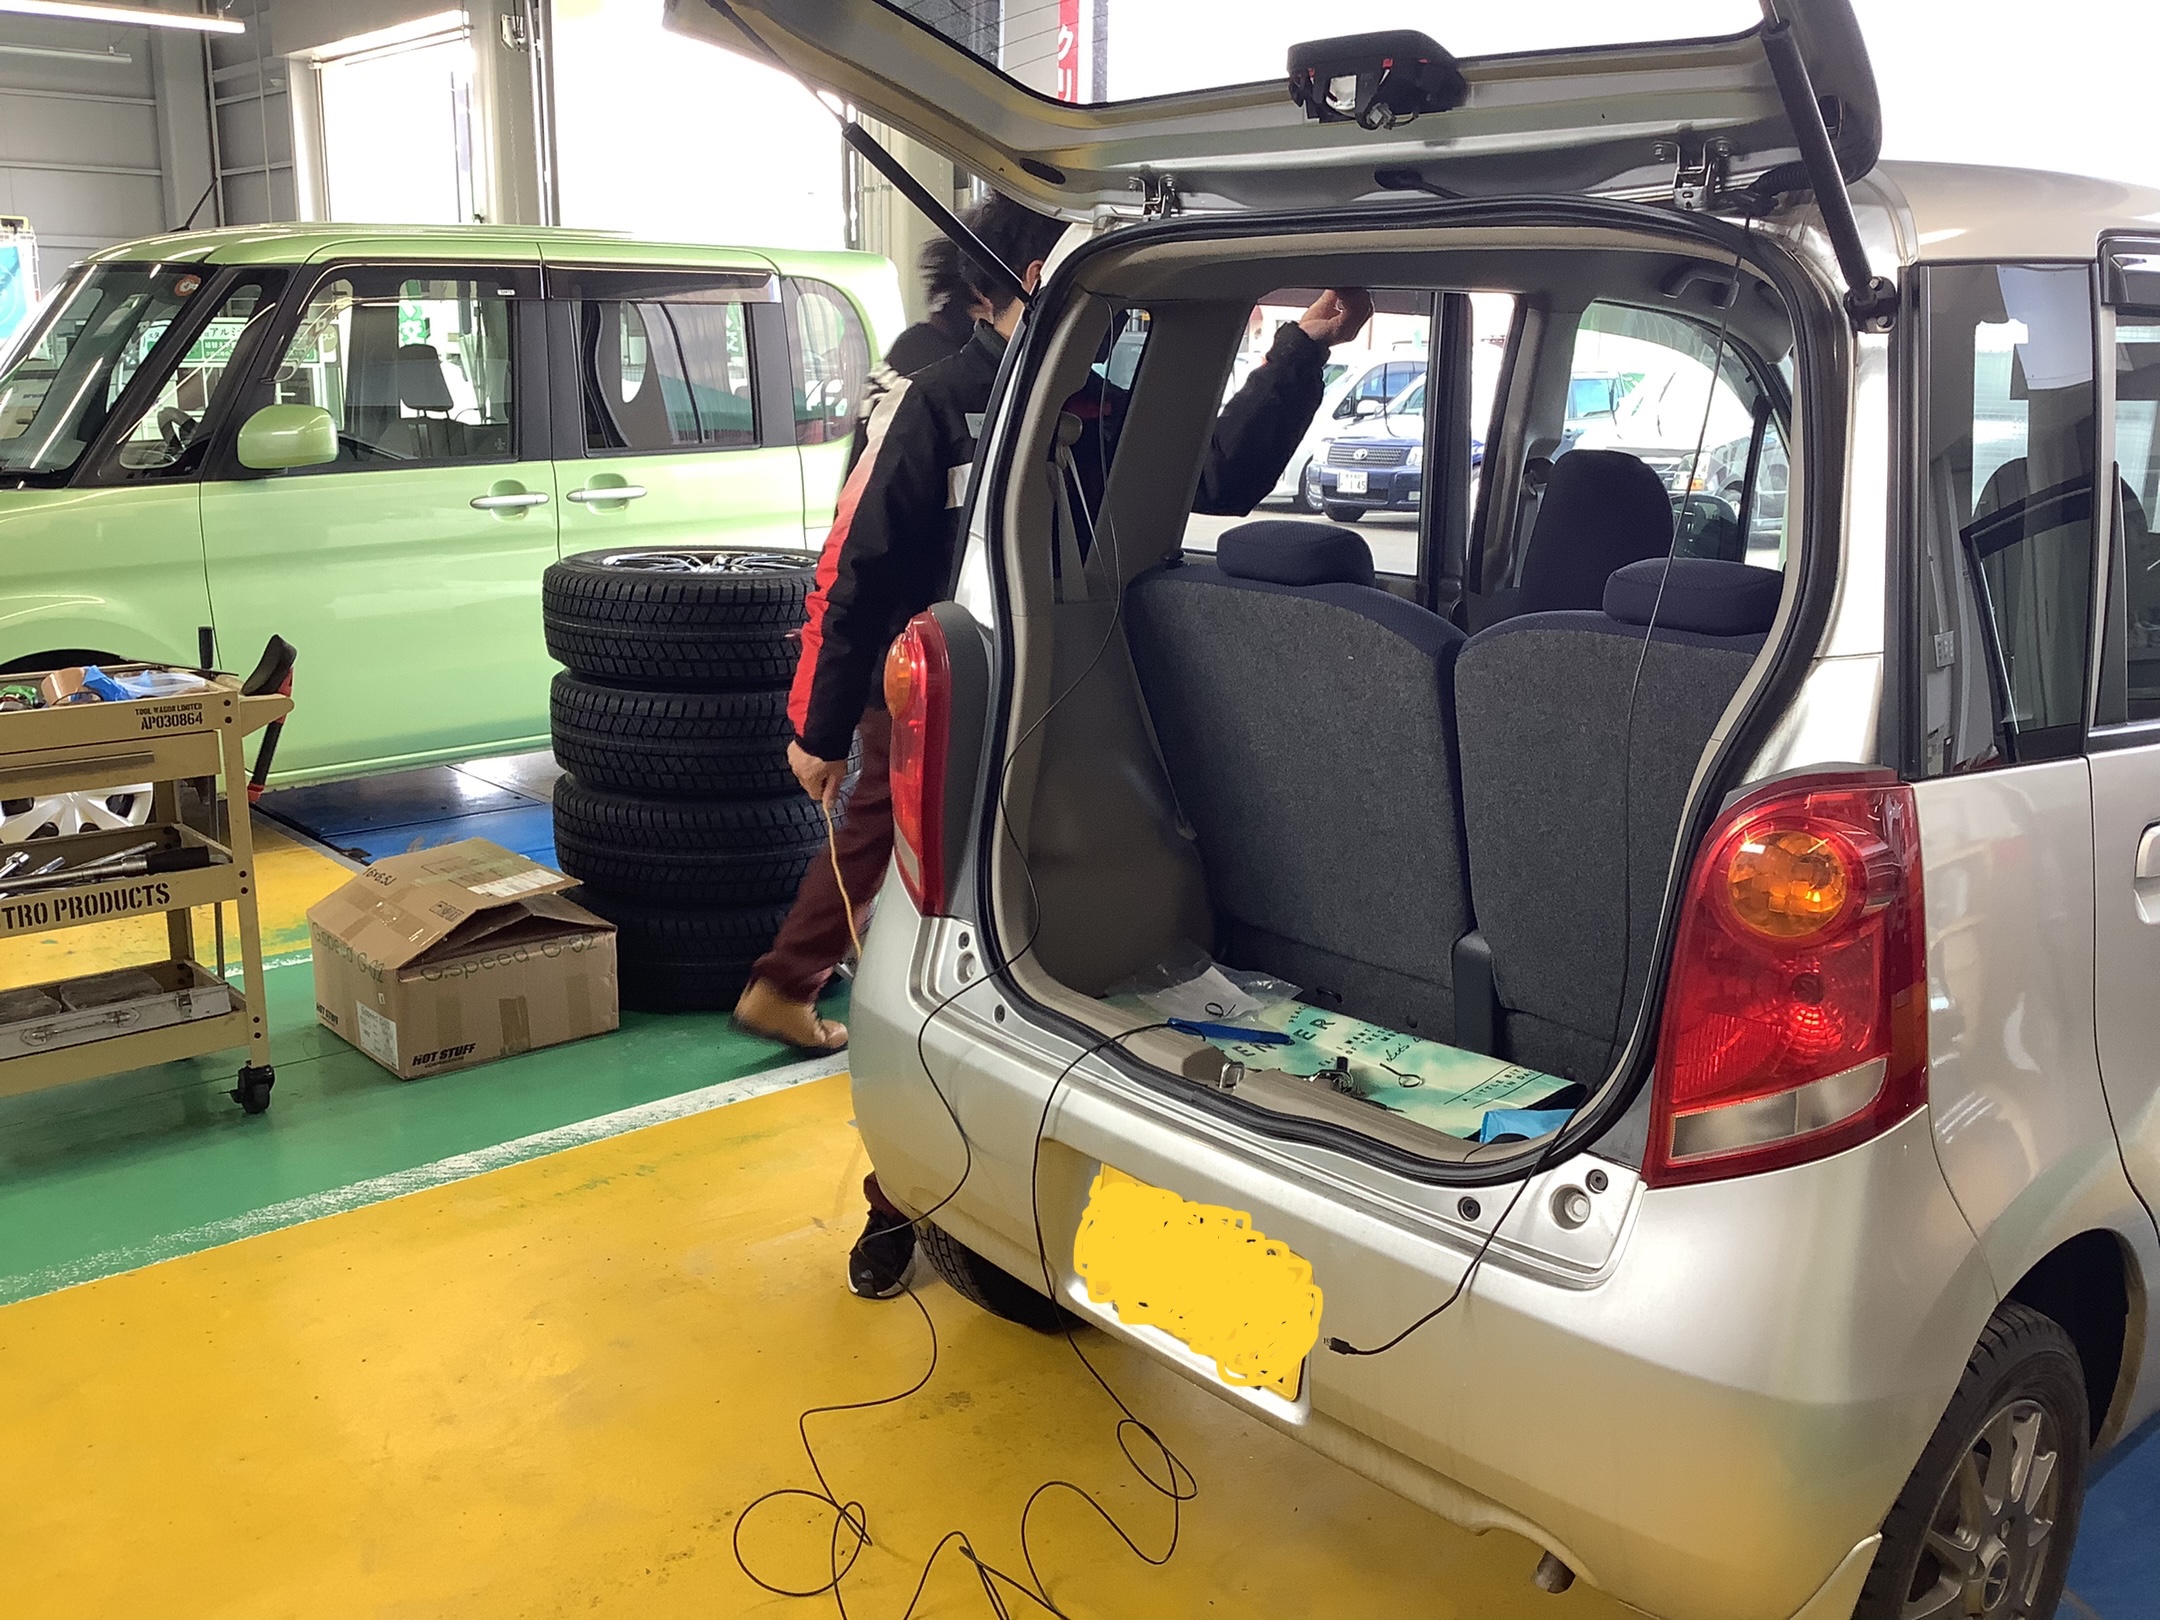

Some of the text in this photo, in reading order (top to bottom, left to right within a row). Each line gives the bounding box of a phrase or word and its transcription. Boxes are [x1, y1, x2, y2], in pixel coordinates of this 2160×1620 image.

[135, 703, 203, 716] TOOL WAGON LIMITED
[141, 712, 203, 730] AP030864
[1, 883, 170, 929] TRO PRODUCTS
[541, 935, 598, 960] G-02
[412, 1043, 477, 1066] HOT STUFF
